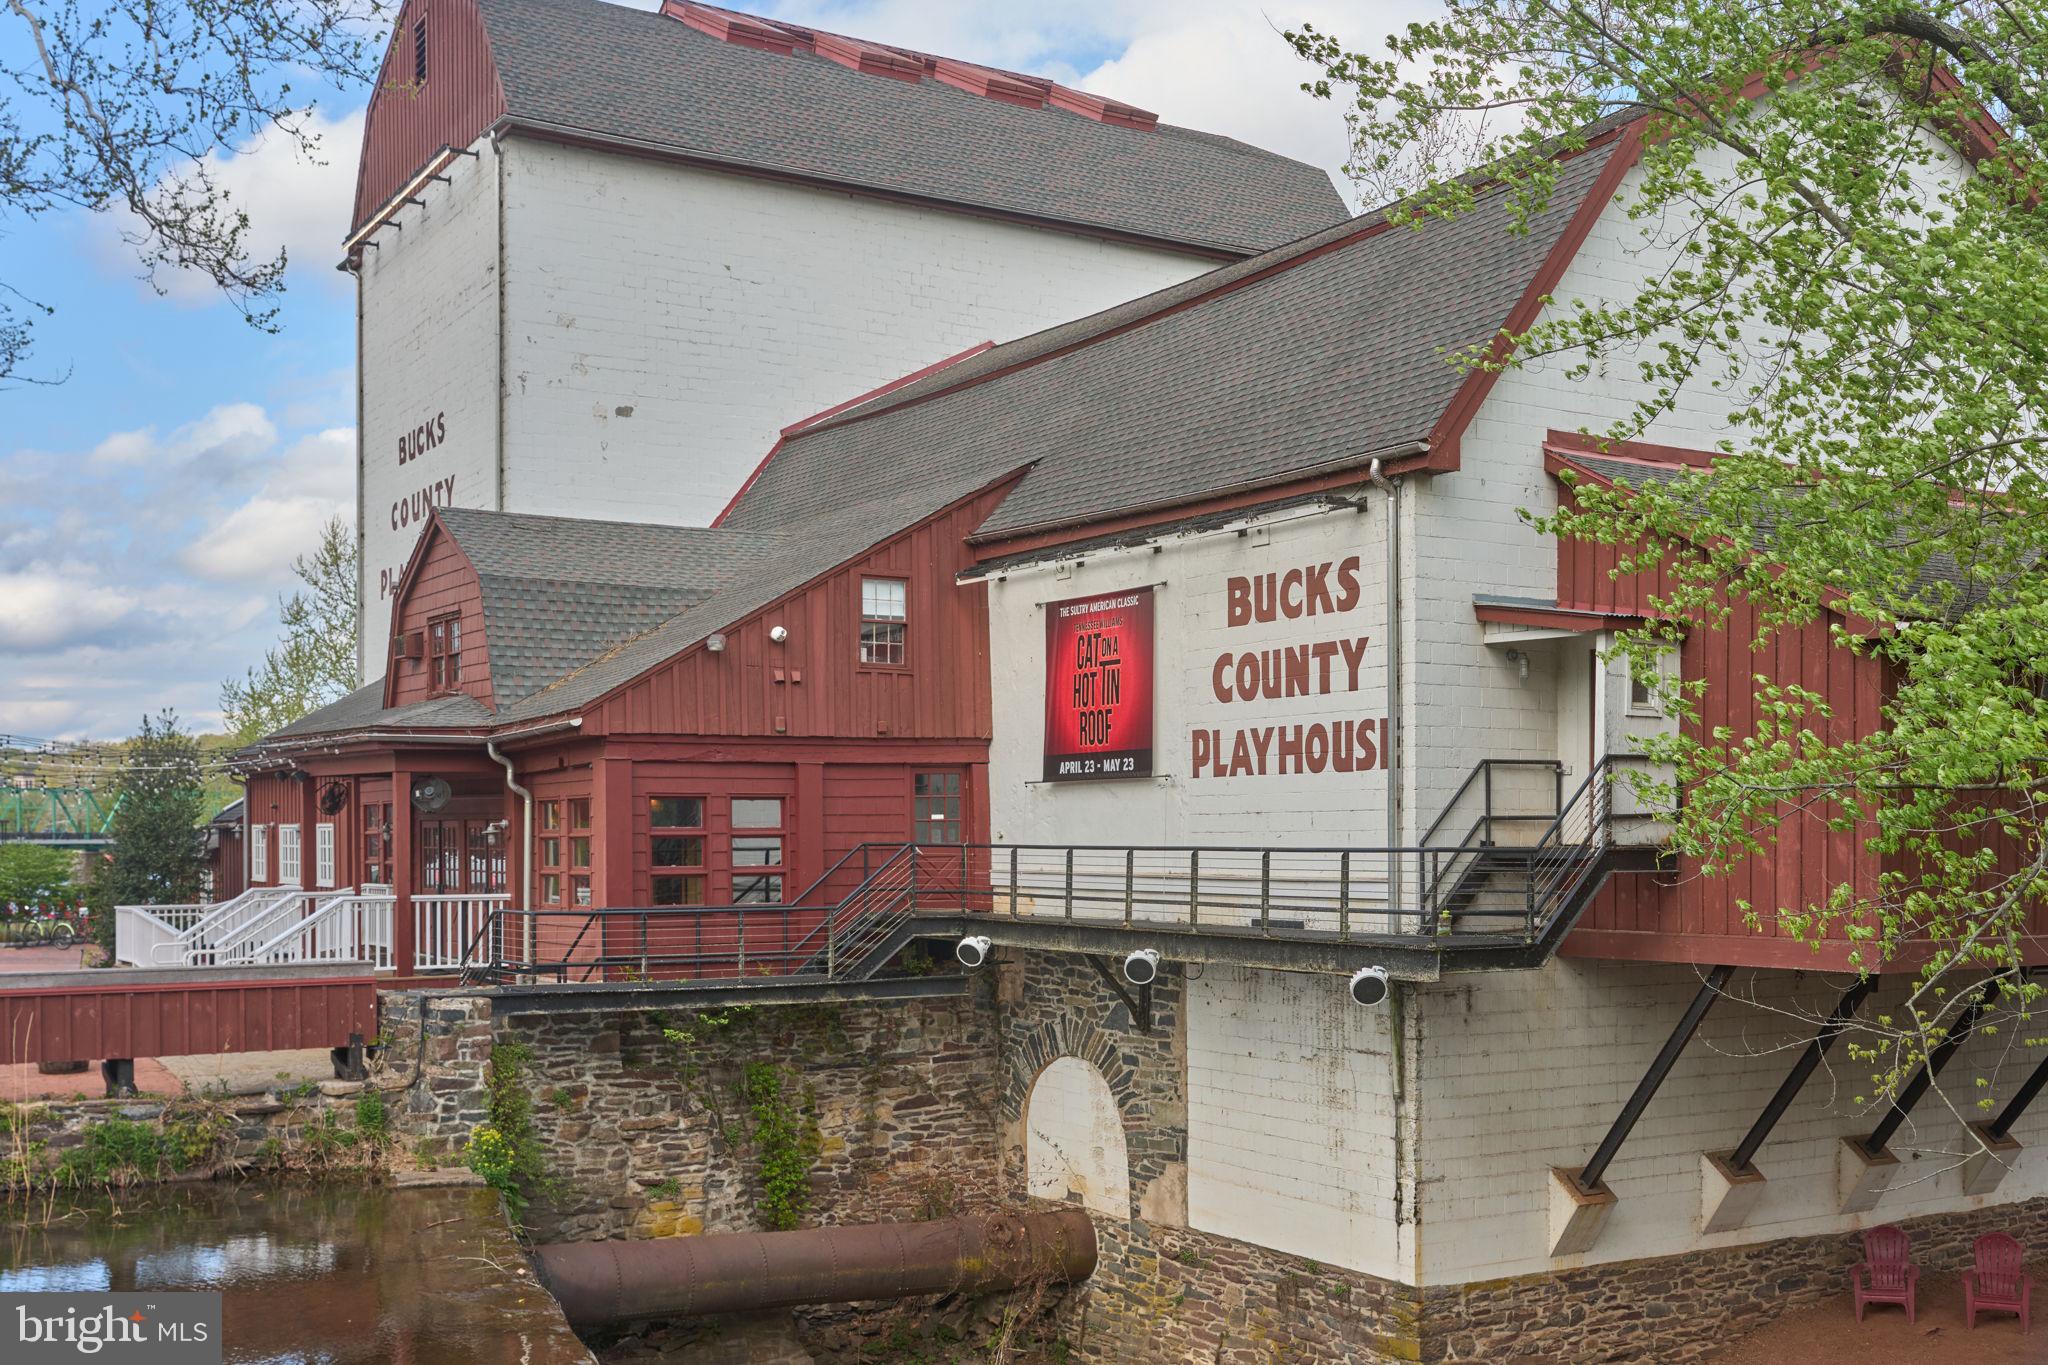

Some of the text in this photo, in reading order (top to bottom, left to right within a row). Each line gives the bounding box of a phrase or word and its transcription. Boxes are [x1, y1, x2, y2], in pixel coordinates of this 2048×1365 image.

[399, 411, 445, 465] BUCKS
[391, 474, 456, 531] COUNTY
[1060, 595, 1139, 618] THE SULTRY AMERICAN CLASSIC
[1227, 556, 1361, 628] BUCKS
[1077, 633, 1118, 669] CAT ON A
[1212, 636, 1370, 704] COUNTY
[1073, 659, 1121, 709] HOT TIN
[1079, 709, 1112, 746] ROOF
[1060, 758, 1134, 774] APRIL 23 MAY 23
